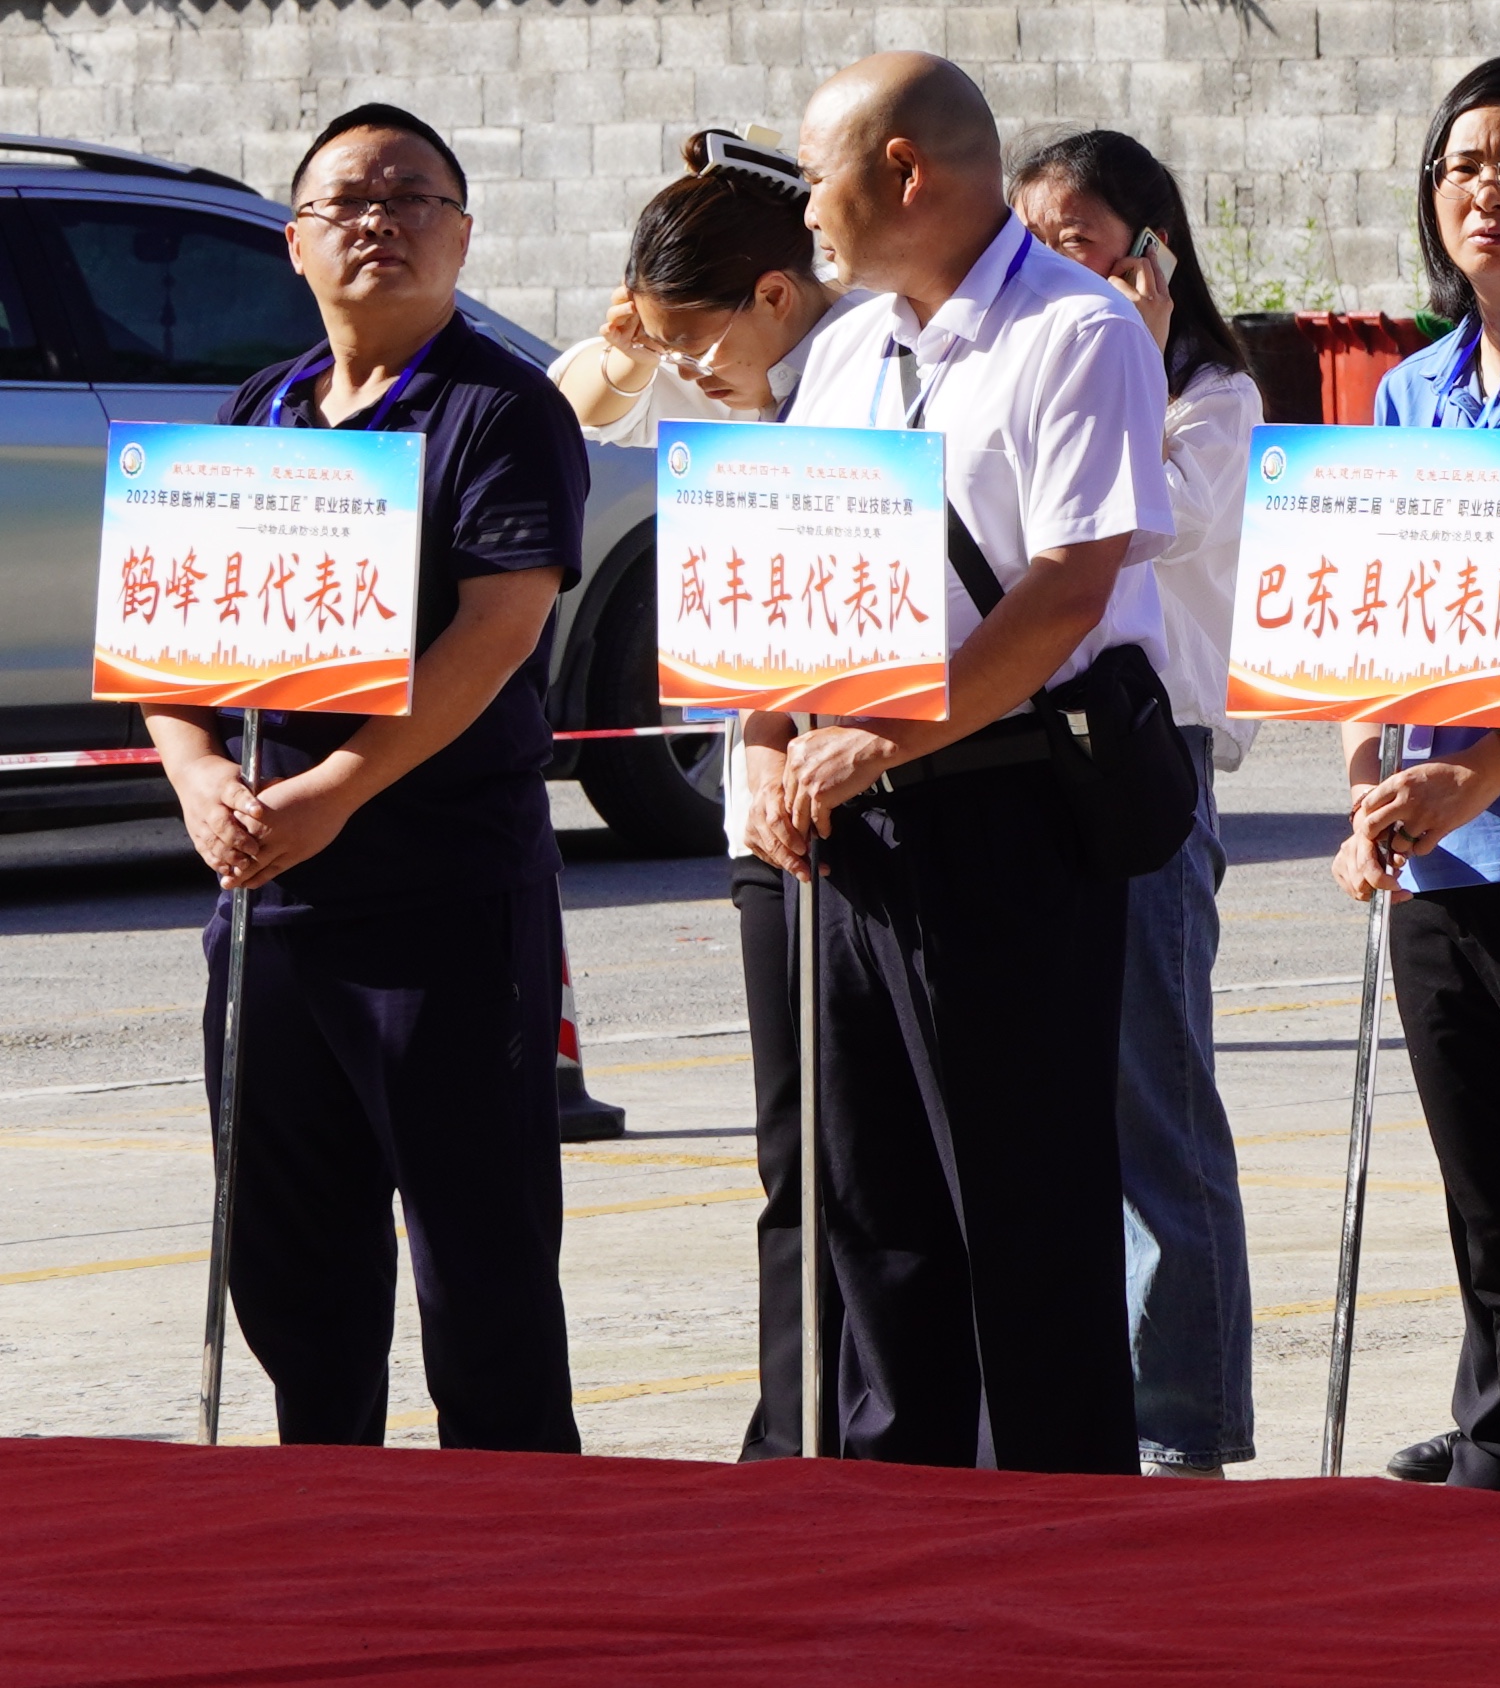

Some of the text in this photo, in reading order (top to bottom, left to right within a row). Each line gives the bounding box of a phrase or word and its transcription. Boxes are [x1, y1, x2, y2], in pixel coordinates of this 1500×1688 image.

[117, 544, 397, 633] 鹤峰县代表队
[677, 545, 929, 638] 咸丰县代表队
